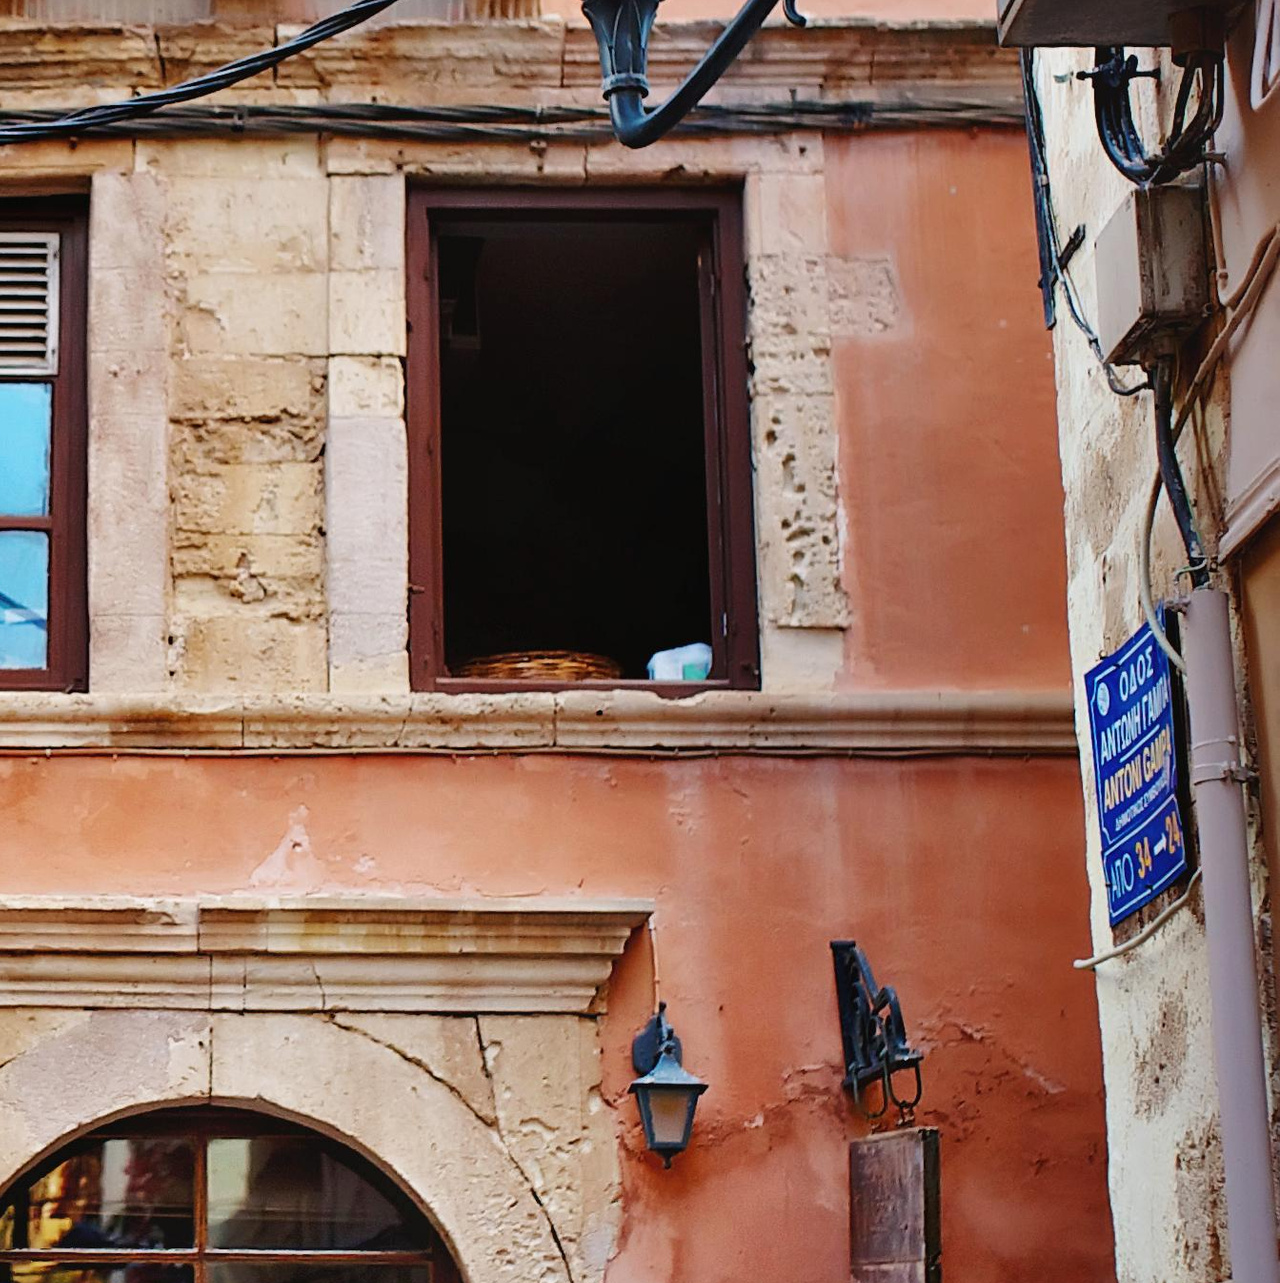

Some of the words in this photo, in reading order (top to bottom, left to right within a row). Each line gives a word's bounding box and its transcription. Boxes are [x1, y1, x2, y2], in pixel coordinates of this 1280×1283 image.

[1119, 645, 1154, 702] ΟΔΟΣ
[1101, 702, 1142, 766] ΑΝΤΩΝΗ
[1104, 753, 1142, 814] ANTONI
[1111, 853, 1135, 903] ΑΠΟ
[1135, 836, 1152, 879] 34
[1165, 811, 1181, 854] 24
